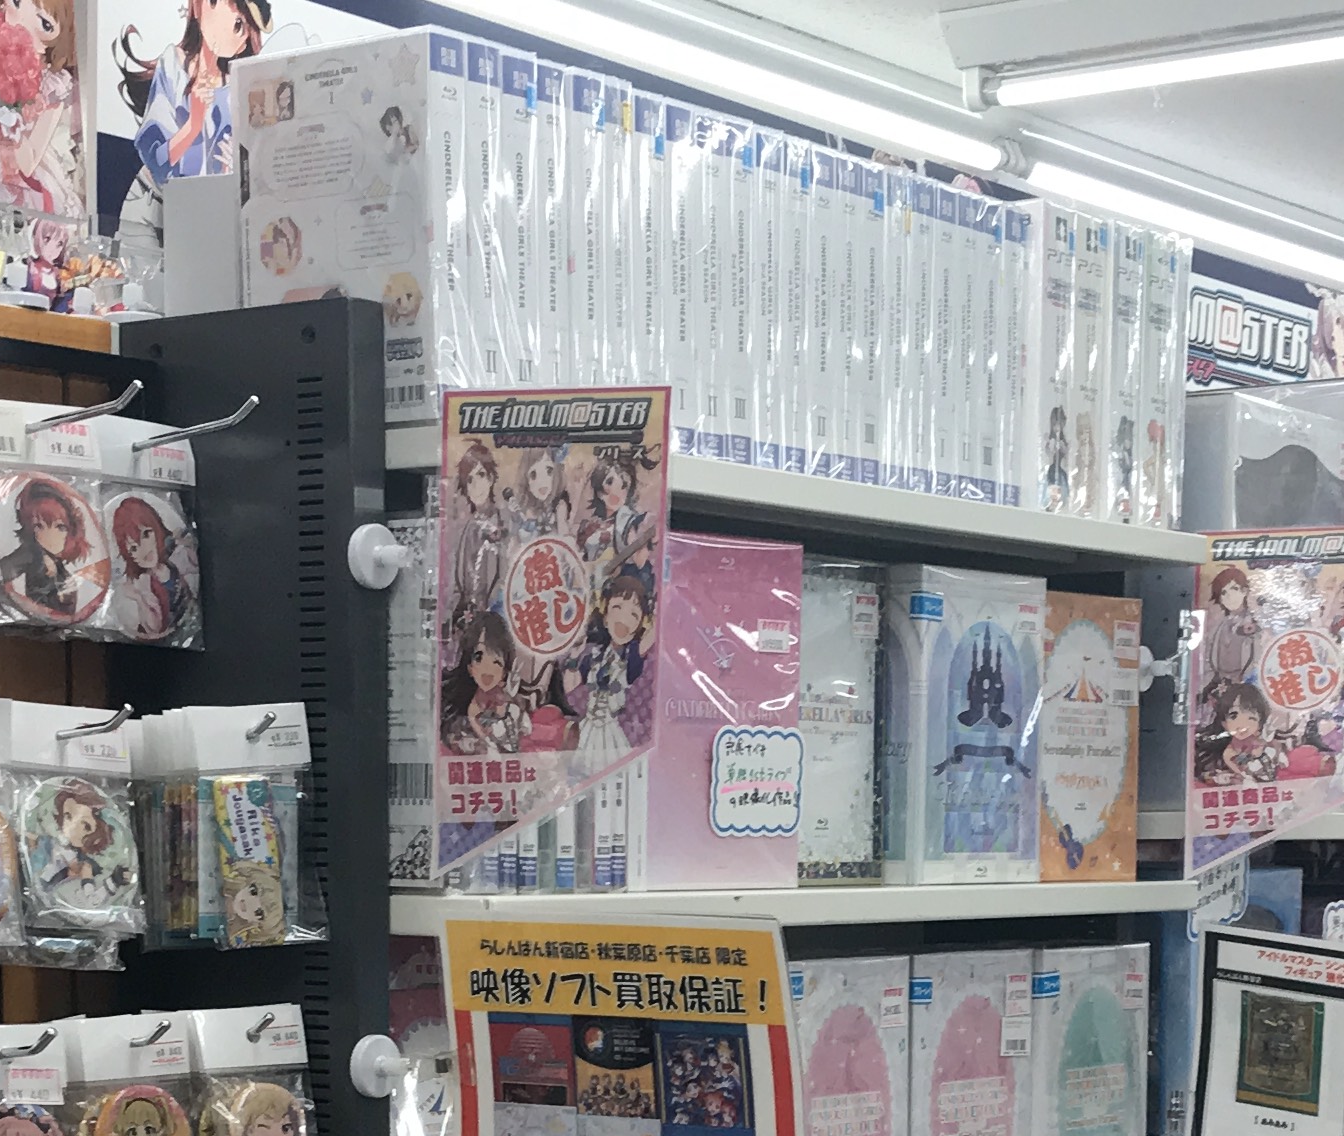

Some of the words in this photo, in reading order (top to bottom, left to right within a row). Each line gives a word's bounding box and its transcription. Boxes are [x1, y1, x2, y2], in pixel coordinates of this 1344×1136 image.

[469, 966, 768, 1015] 映像ソフト買取保証！
